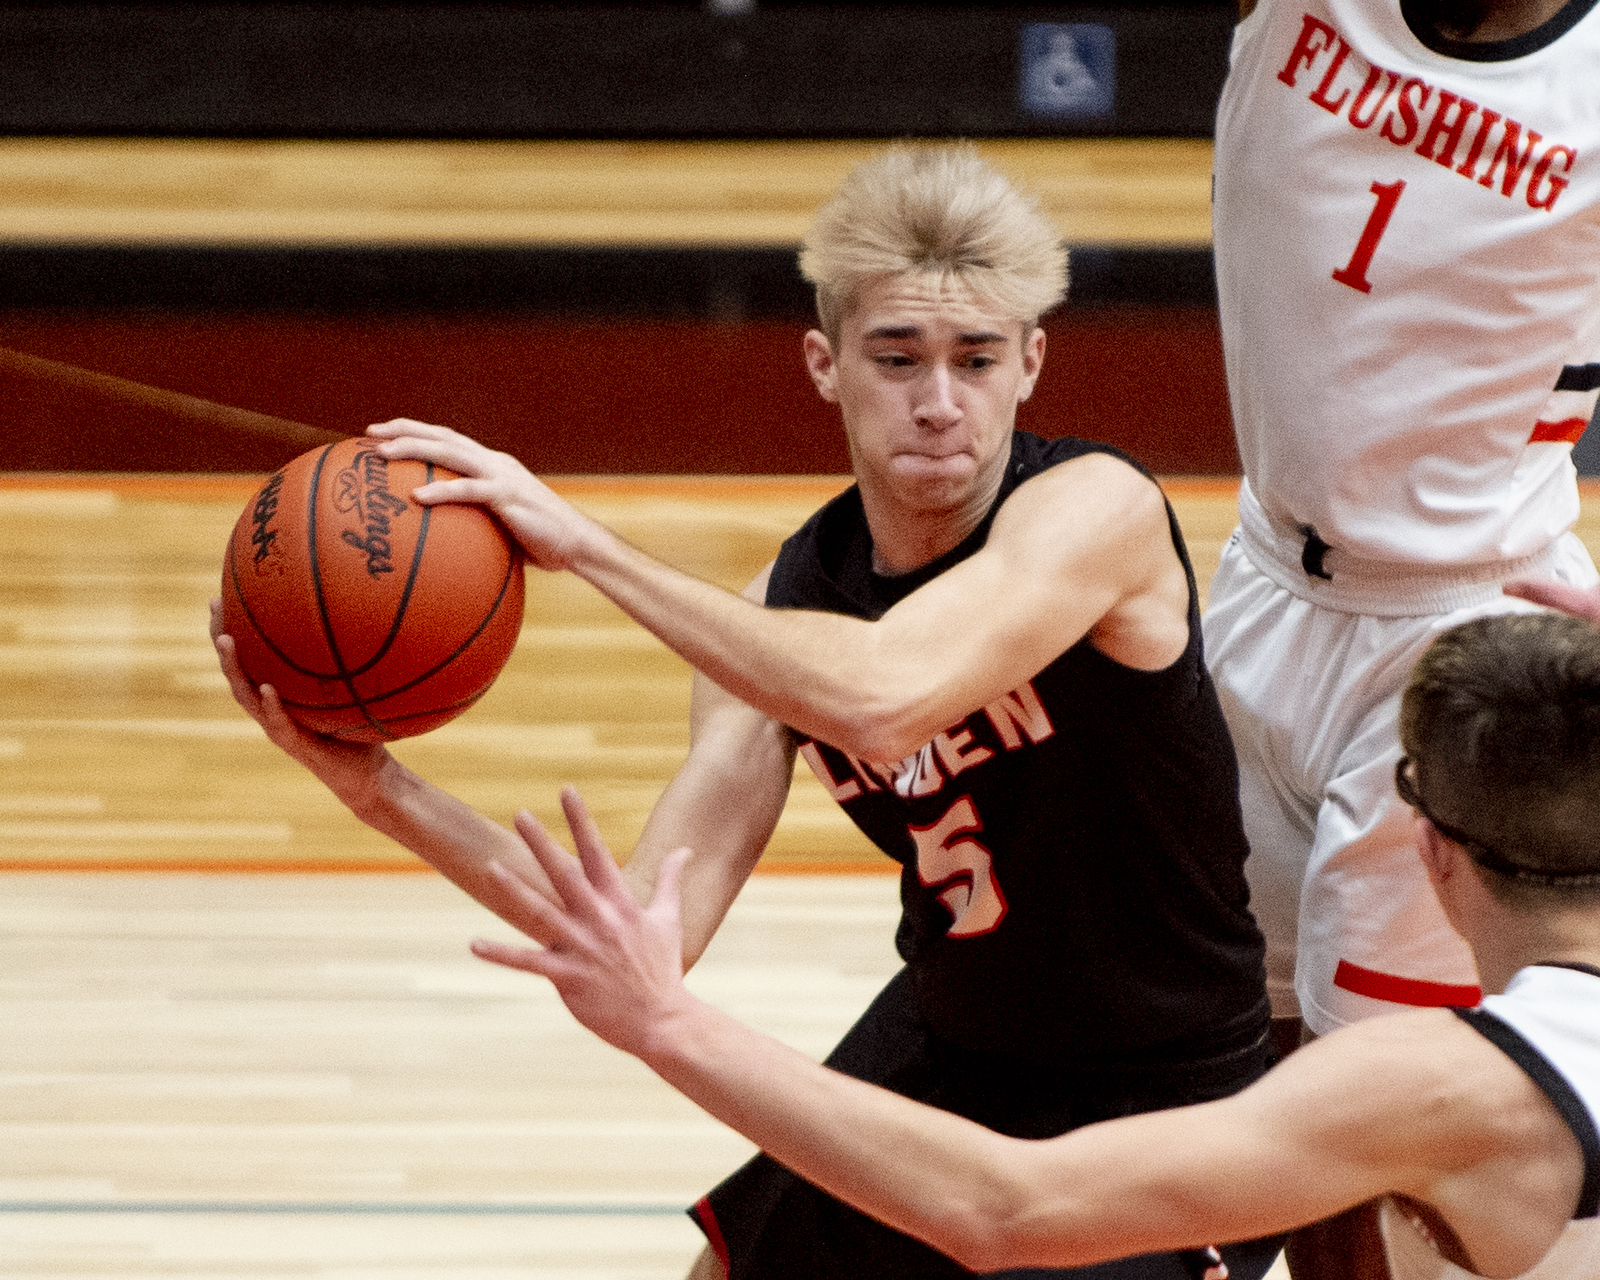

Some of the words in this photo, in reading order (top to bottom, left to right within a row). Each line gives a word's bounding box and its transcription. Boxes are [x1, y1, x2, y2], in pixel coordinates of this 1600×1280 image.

[1276, 13, 1578, 213] FLUSHING
[1331, 178, 1407, 294] 1
[341, 437, 407, 581] awlings
[907, 793, 1009, 940] 5
